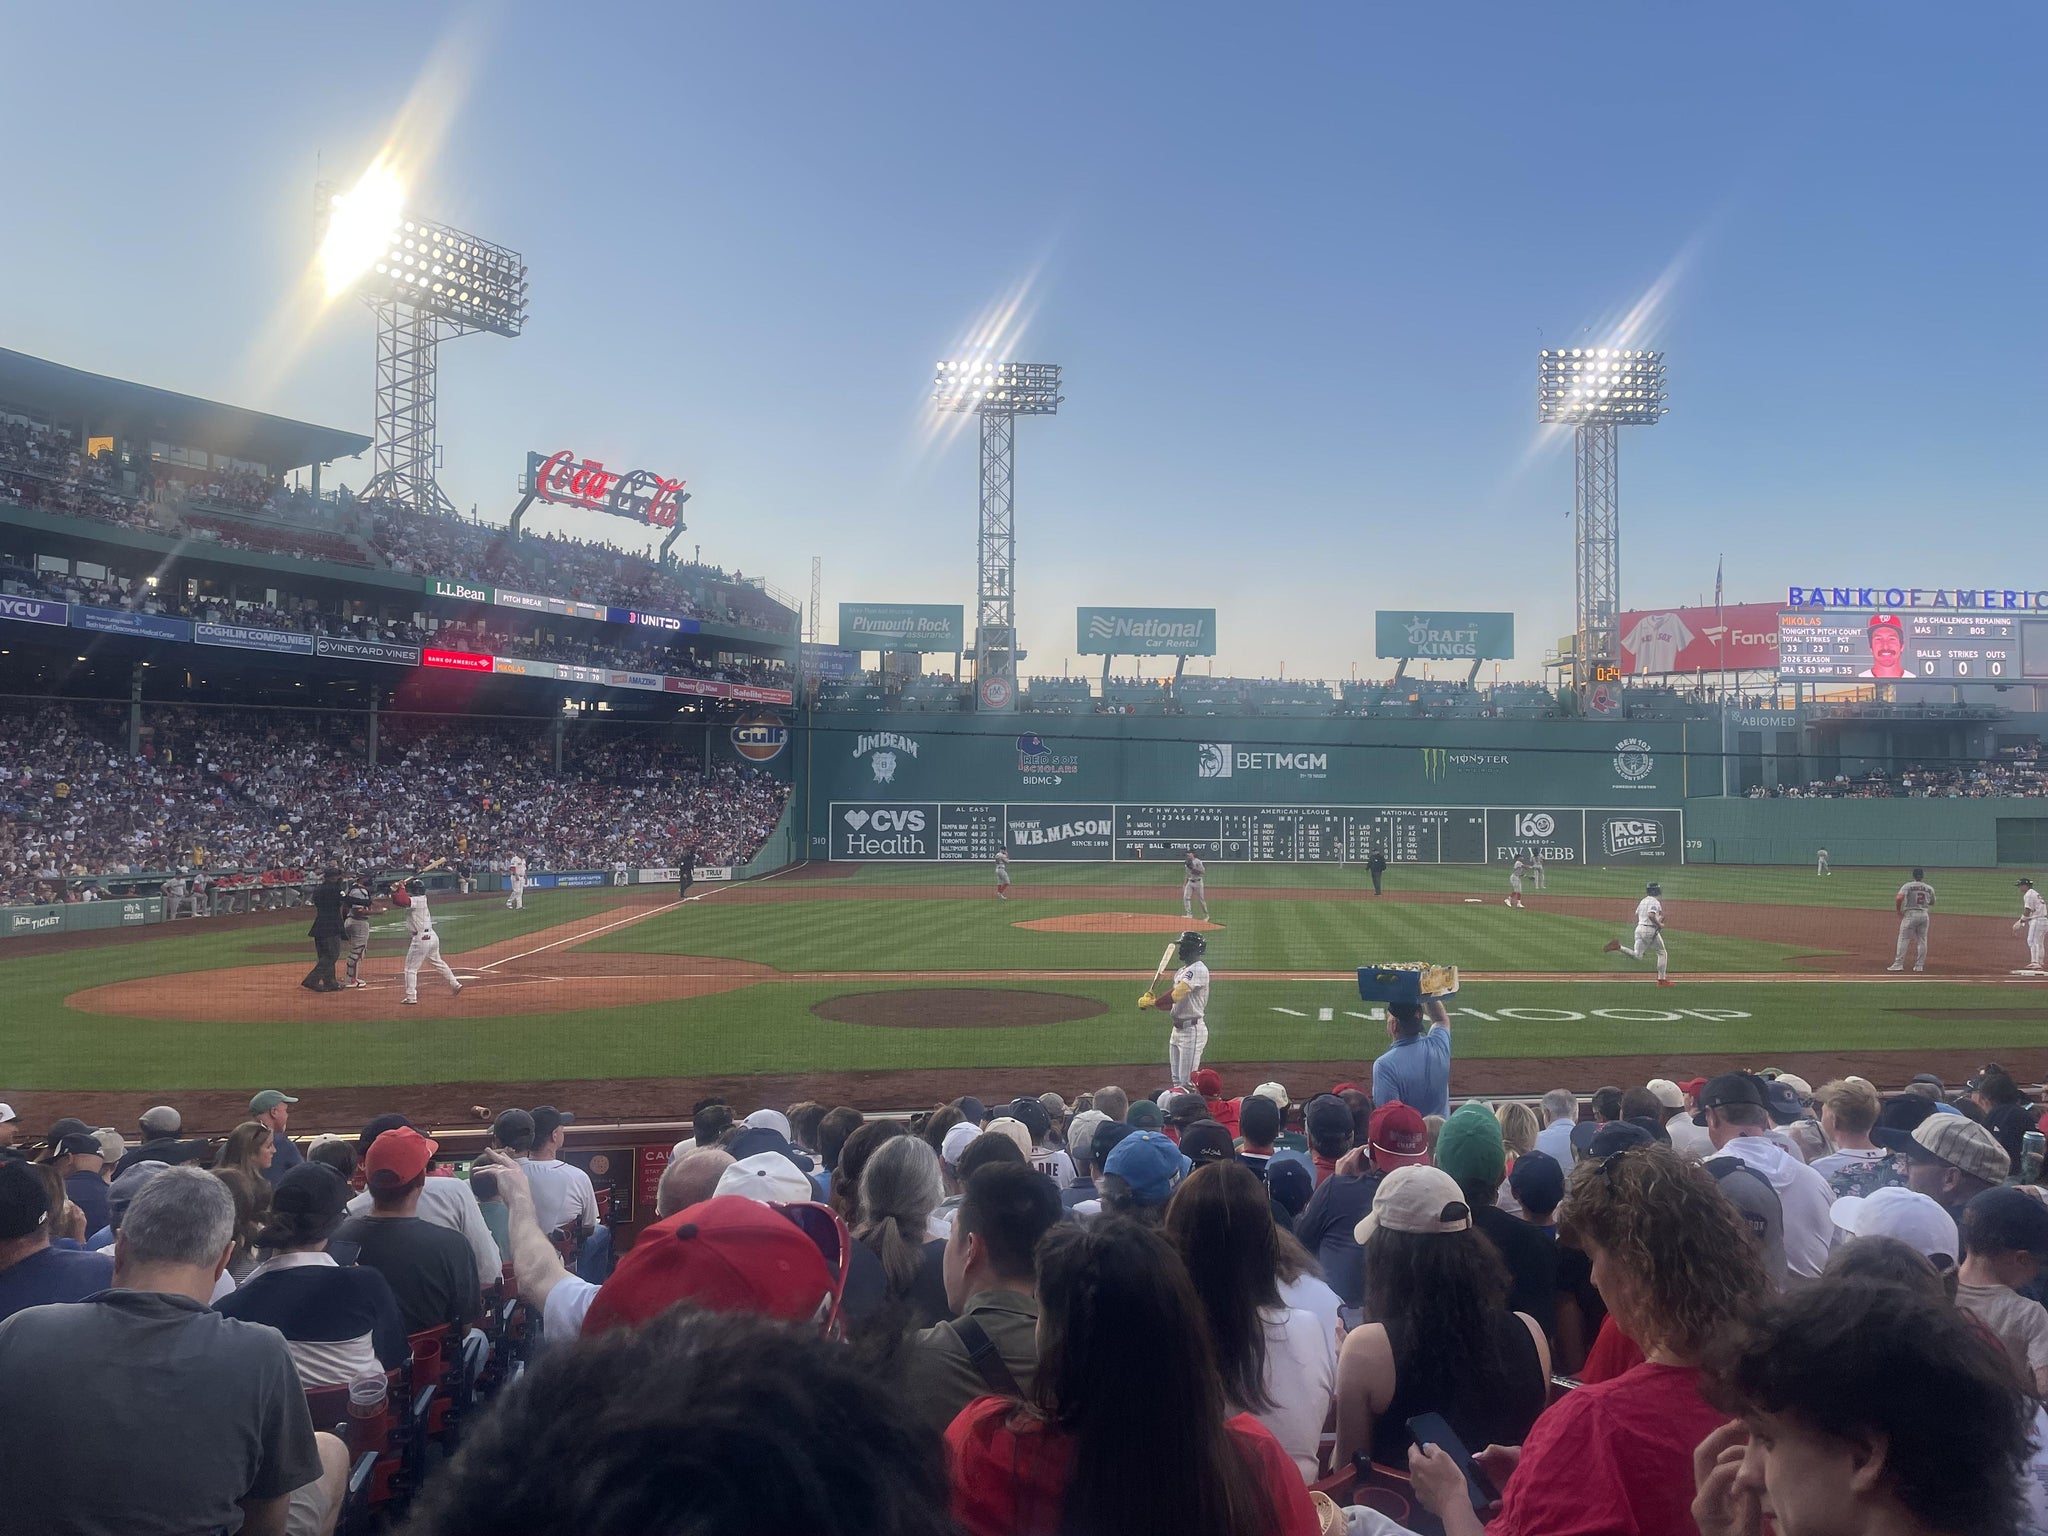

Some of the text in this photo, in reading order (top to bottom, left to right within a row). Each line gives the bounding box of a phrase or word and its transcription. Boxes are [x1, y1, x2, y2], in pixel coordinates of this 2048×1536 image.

[436, 582, 485, 601] L.L.Bean
[1788, 586, 1874, 608] BANK
[1885, 588, 1923, 609] OF
[503, 595, 542, 607] PITCH BREAK
[641, 614, 681, 630] UNITED
[853, 616, 951, 632] Plymouth Rock
[1781, 617, 1822, 626] MIKOLAS
[1929, 617, 1973, 625] CHALLENGES
[98, 622, 113, 630] Israel
[113, 624, 140, 634] Deaconess
[140, 628, 159, 636] Medical
[1115, 618, 1203, 637] National
[1914, 626, 2007, 635] WAS 2 BOS 2
[198, 625, 312, 646] COGHLIN COMPANIES
[906, 631, 953, 639] assurance
[1408, 627, 1478, 645] DRAFT
[1656, 632, 1673, 643] SOX
[1145, 639, 1199, 648] Car Rental
[1417, 642, 1476, 655] KINGS
[1838, 645, 1849, 653] 70
[330, 643, 416, 660] VINEYARD VINES
[1916, 650, 1942, 658] BALLS
[497, 664, 526, 674] MIKOLAS
[1597, 667, 1620, 681] 0:24
[1925, 661, 2001, 675] 0 0 0
[678, 681, 718, 693] Ninety Nine
[733, 688, 762, 699] Safelite
[1742, 717, 1796, 726] ABIOMED
[733, 726, 785, 745] Gulf
[1615, 738, 1652, 752] IBEW 103
[1023, 756, 1078, 765] RED SOX
[1236, 752, 1327, 770] BETMGM
[1023, 765, 1078, 773] SCHOLARS
[1023, 776, 1052, 785] BIDMC
[871, 810, 925, 831] CVS
[1008, 821, 1025, 829] WHO
[1515, 813, 1555, 837] 160
[1614, 821, 1657, 837] ACE
[812, 837, 826, 845] 310
[847, 834, 925, 854] Health
[1616, 835, 1657, 848] TICKET
[1685, 840, 1702, 848] 379
[1916, 893, 1925, 905] 2
[124, 905, 134, 915] city
[15, 916, 60, 930] ACE TICKET
